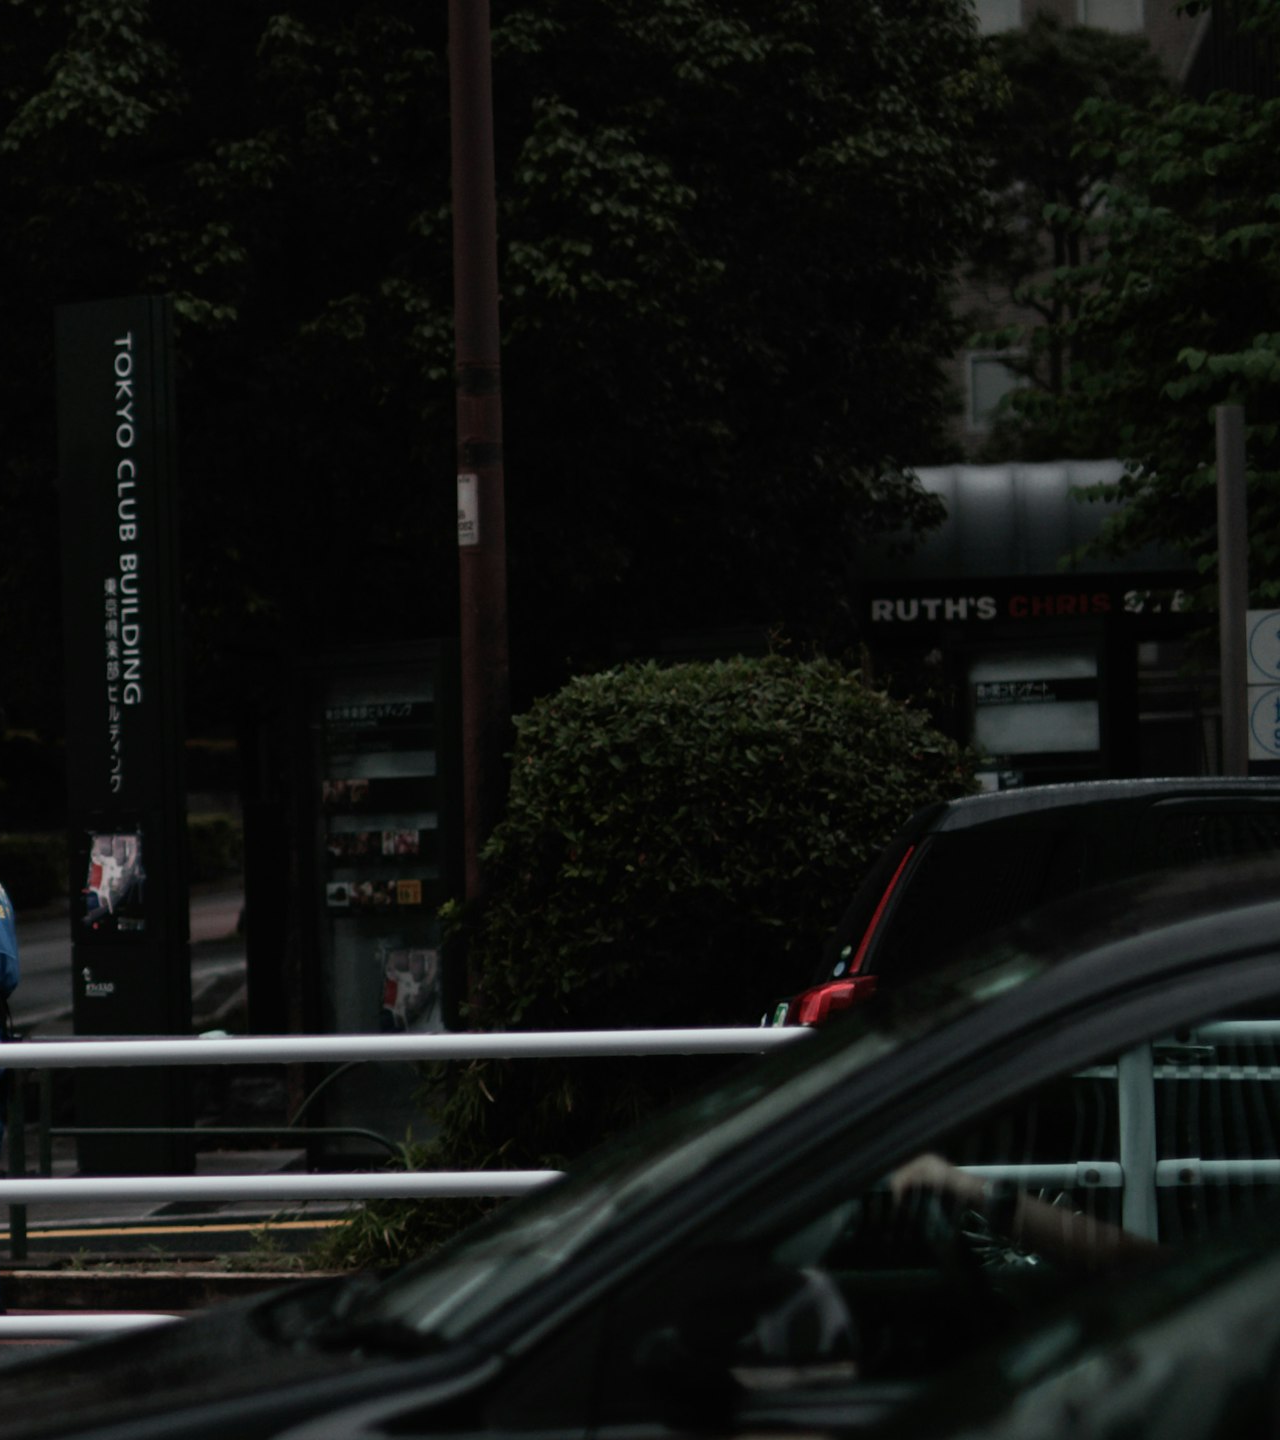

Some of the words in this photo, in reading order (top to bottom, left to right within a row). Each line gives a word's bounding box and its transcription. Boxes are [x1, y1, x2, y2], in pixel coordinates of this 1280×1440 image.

[113, 330, 134, 449] TOKYO
[116, 458, 138, 542] CLUB
[118, 552, 142, 705] BUILDING
[871, 597, 998, 622] RUTH'S
[1007, 593, 1111, 618] CHRIS
